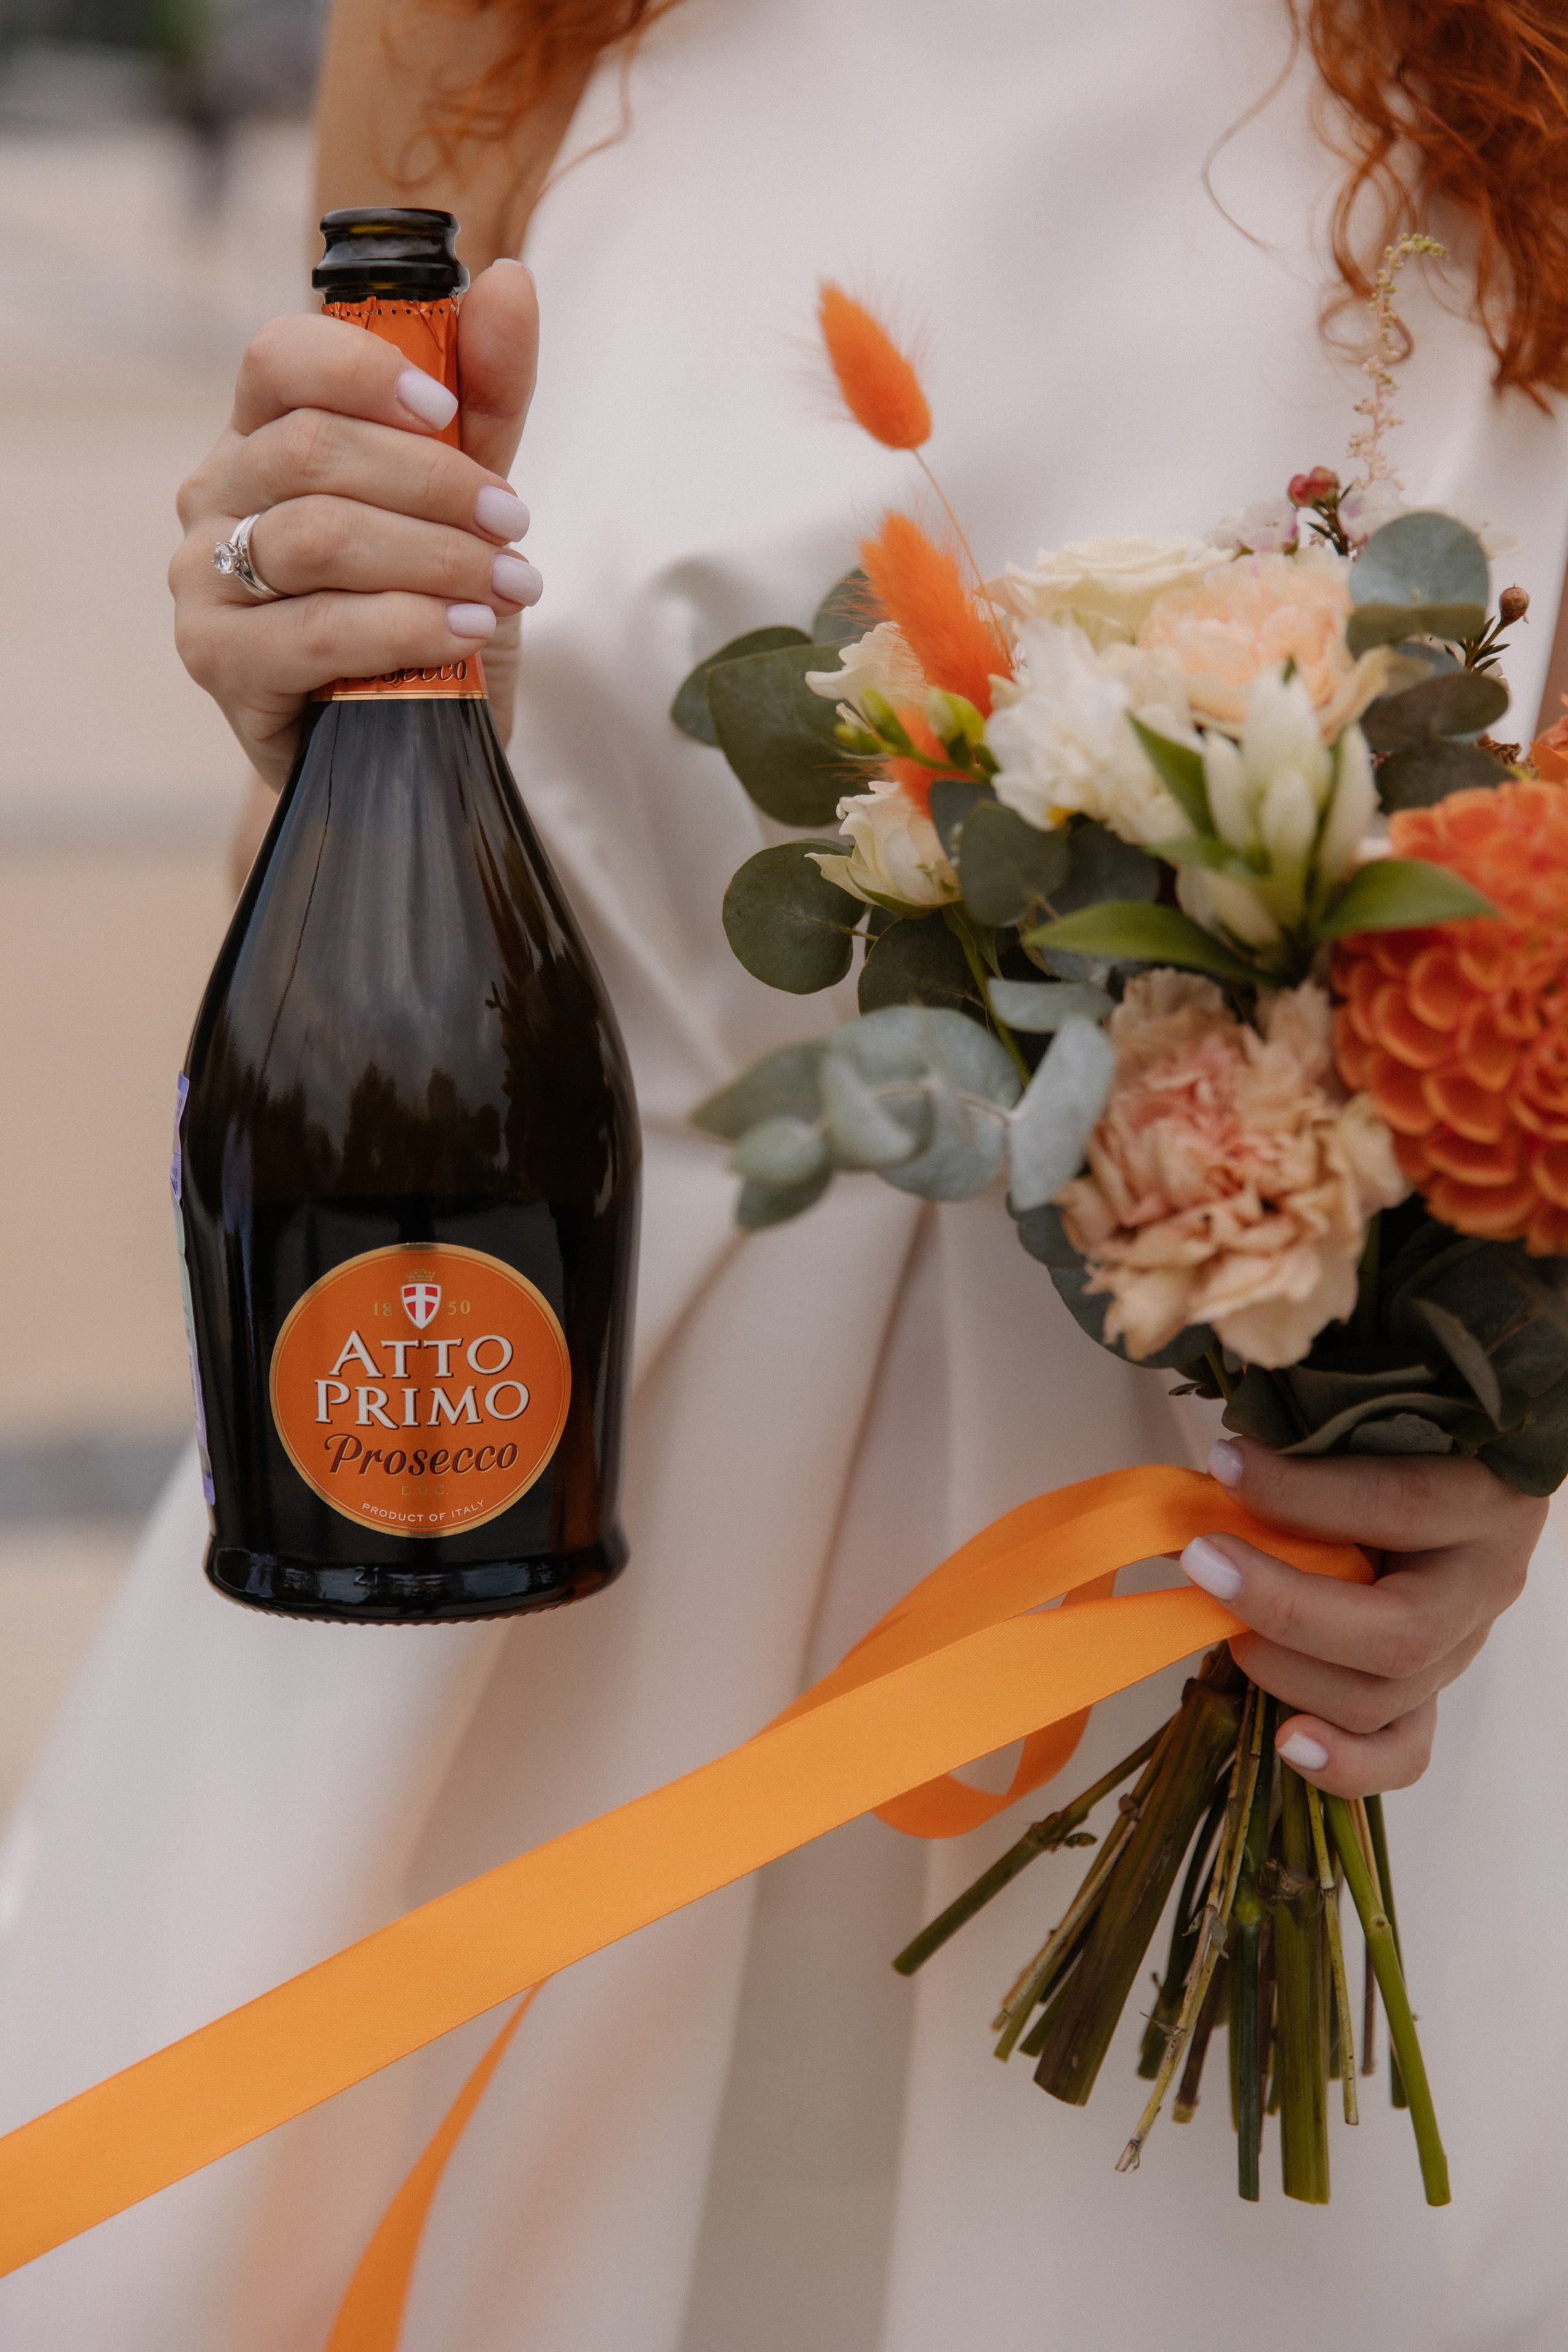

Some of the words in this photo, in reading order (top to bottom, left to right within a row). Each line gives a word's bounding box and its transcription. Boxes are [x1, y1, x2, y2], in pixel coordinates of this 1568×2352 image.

[372, 1302, 393, 1316] 18
[447, 1300, 471, 1316] 50
[328, 1330, 514, 1379] ATTO
[314, 1379, 530, 1430] PRIMO
[323, 1433, 519, 1476] Prosecco
[361, 1502, 424, 1522] PRODUCT
[429, 1512, 447, 1522] OF
[451, 1499, 484, 1518] ITALY
